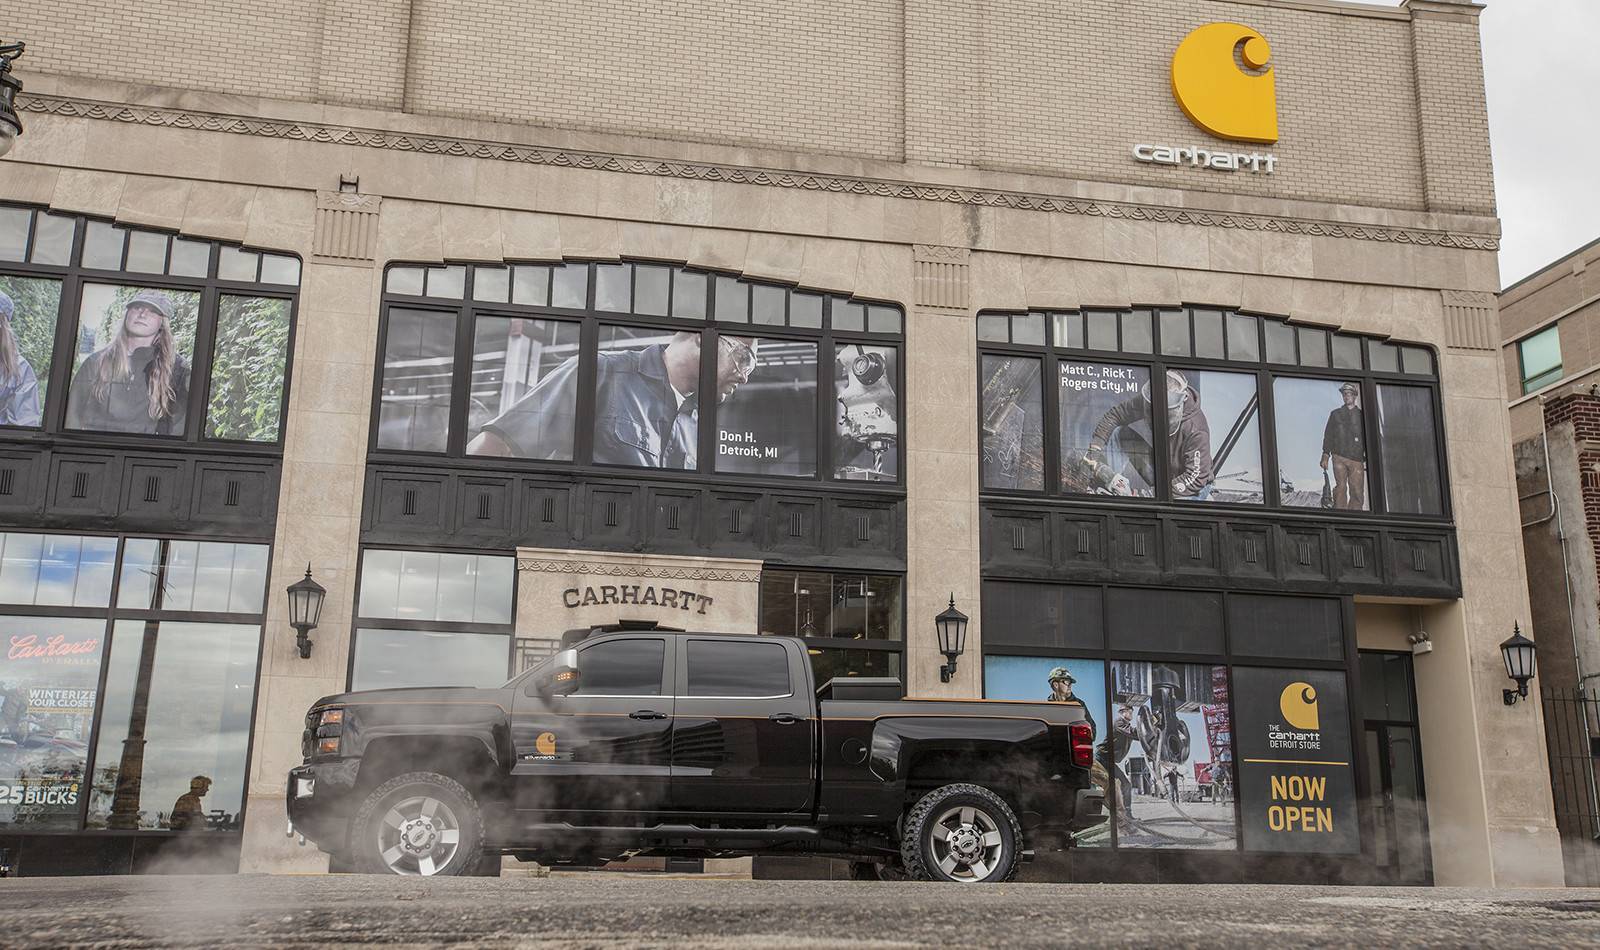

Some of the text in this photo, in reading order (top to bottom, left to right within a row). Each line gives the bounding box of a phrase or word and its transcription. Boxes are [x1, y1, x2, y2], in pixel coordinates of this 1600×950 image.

[1133, 143, 1278, 175] carhartt
[1061, 364, 1135, 380] Matt C., Rick T.
[1061, 377, 1138, 394] Rogers City, MI
[720, 430, 757, 443] Don H.
[720, 444, 778, 458] Detroit, MI
[563, 585, 713, 615] CARHARTT
[29, 689, 96, 699] WINTERIZE
[28, 699, 95, 708] YOUR CLOSET
[1268, 731, 1320, 741] carhartt
[1269, 740, 1321, 750] DETROIT STORE
[1271, 775, 1326, 801] NOW
[25, 791, 77, 804] BUCKS
[1268, 805, 1333, 832] OPEN
